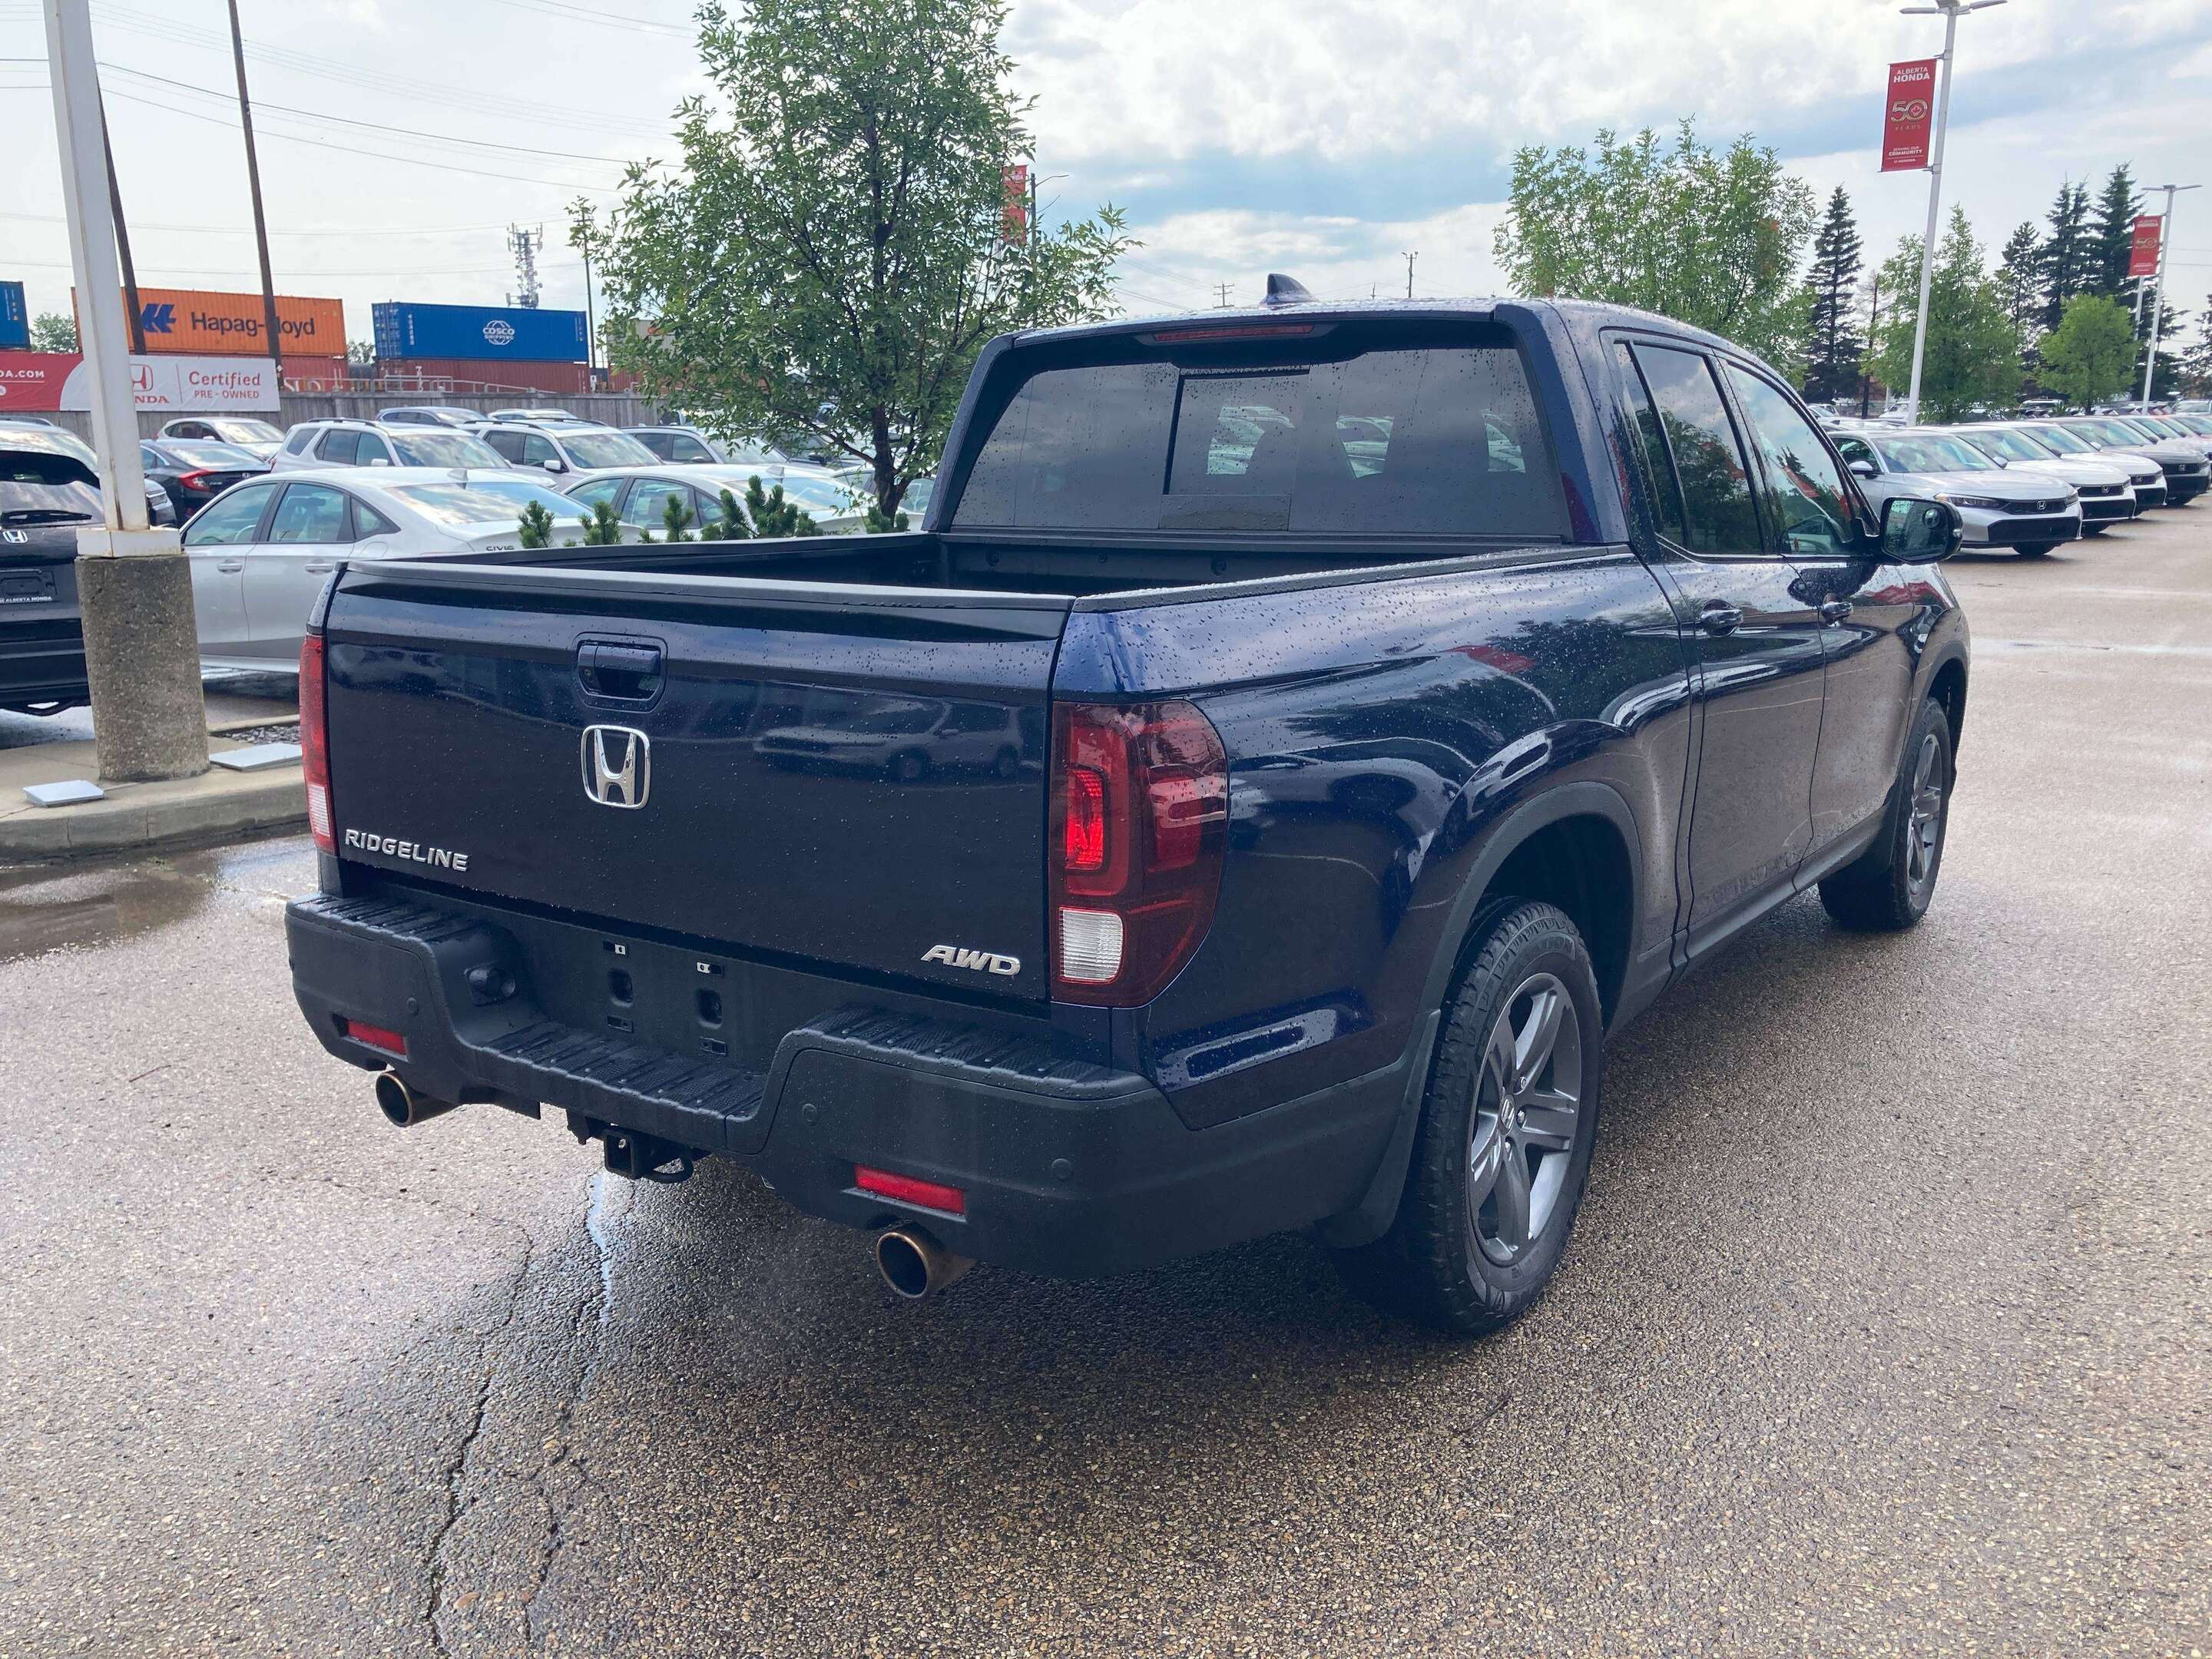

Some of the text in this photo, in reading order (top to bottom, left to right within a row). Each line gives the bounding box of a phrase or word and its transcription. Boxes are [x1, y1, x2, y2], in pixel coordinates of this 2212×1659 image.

[1896, 66, 1929, 75] ALBERTA
[1893, 72, 1930, 83] HONDA
[1890, 98, 1929, 123] 50
[482, 327, 515, 336] COSCO
[189, 371, 261, 389] Certified
[222, 390, 260, 399] OWNED
[134, 396, 170, 405] NDA
[345, 829, 469, 873] RIDGELINE
[921, 945, 1021, 976] AWD
